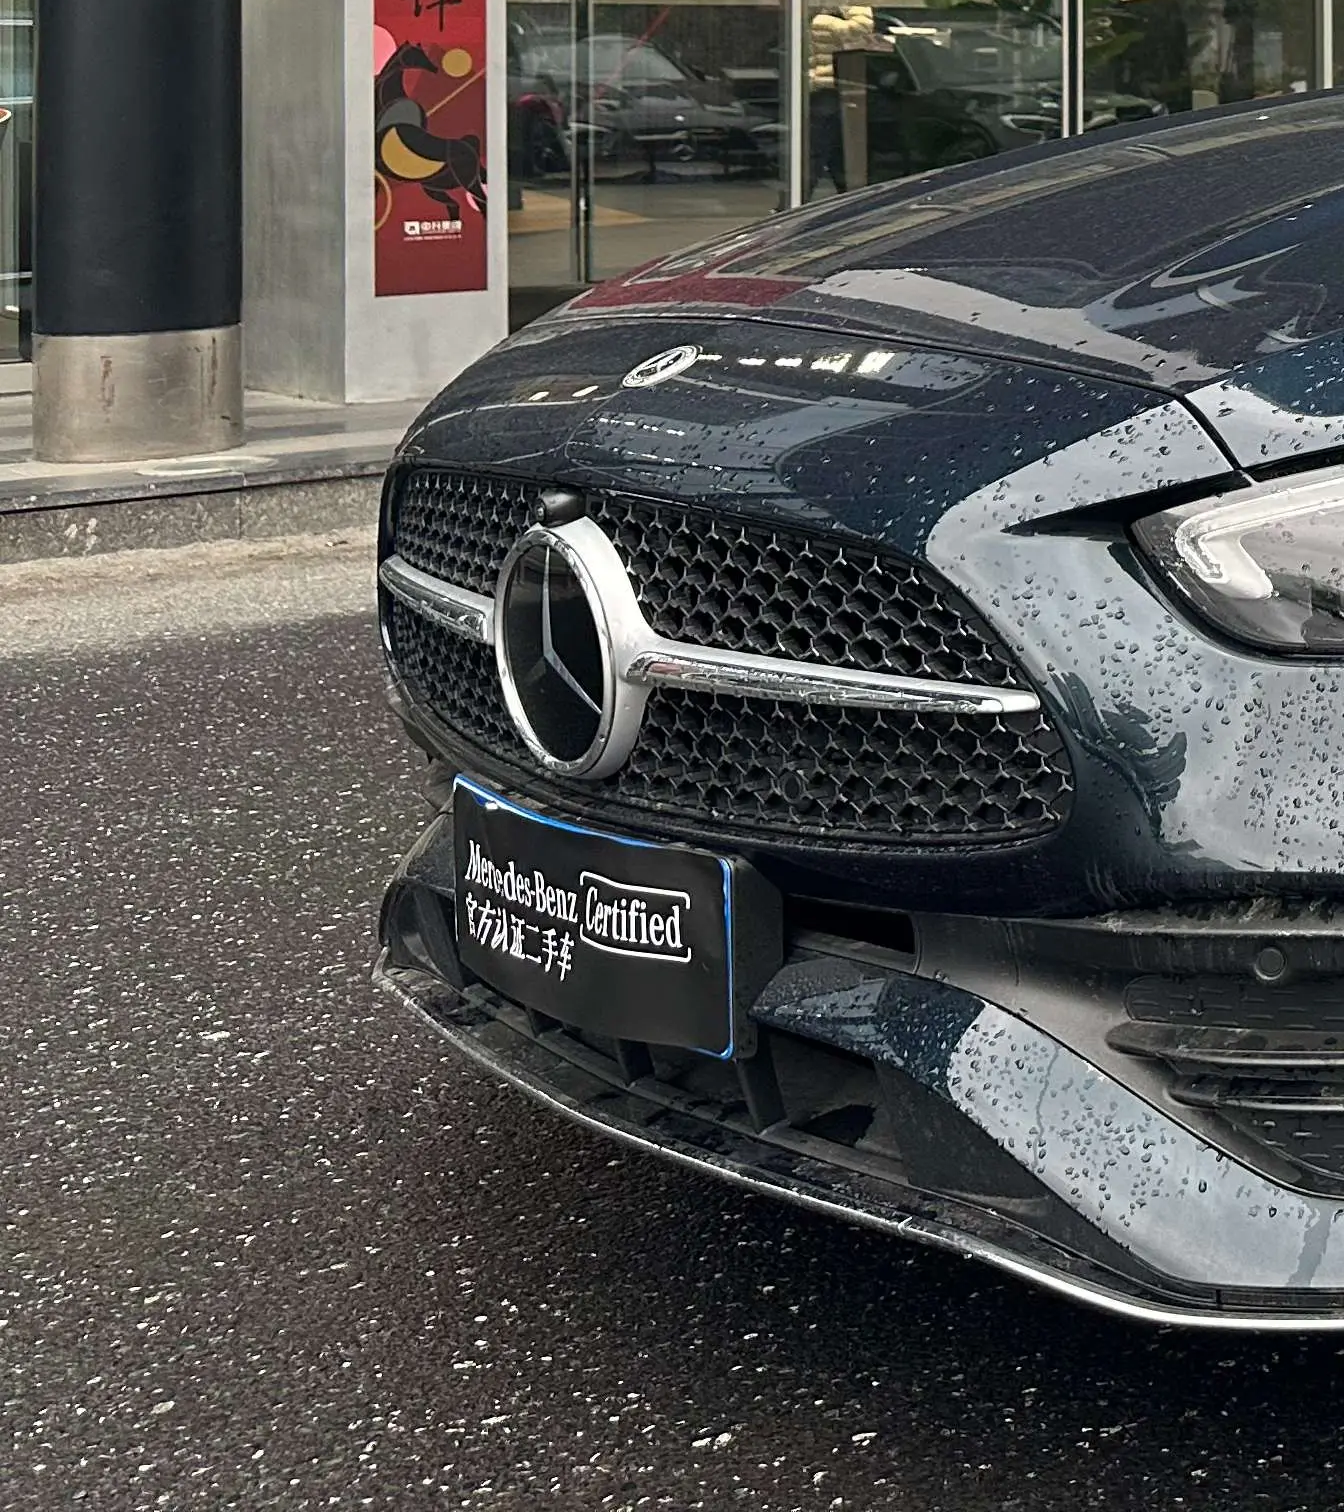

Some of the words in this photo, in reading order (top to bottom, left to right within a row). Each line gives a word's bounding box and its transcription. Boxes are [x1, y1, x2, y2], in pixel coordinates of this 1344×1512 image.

[464, 839, 578, 923] Mercedes-Benz
[584, 885, 683, 949] Certified
[465, 891, 575, 981] 官方认证二手车
